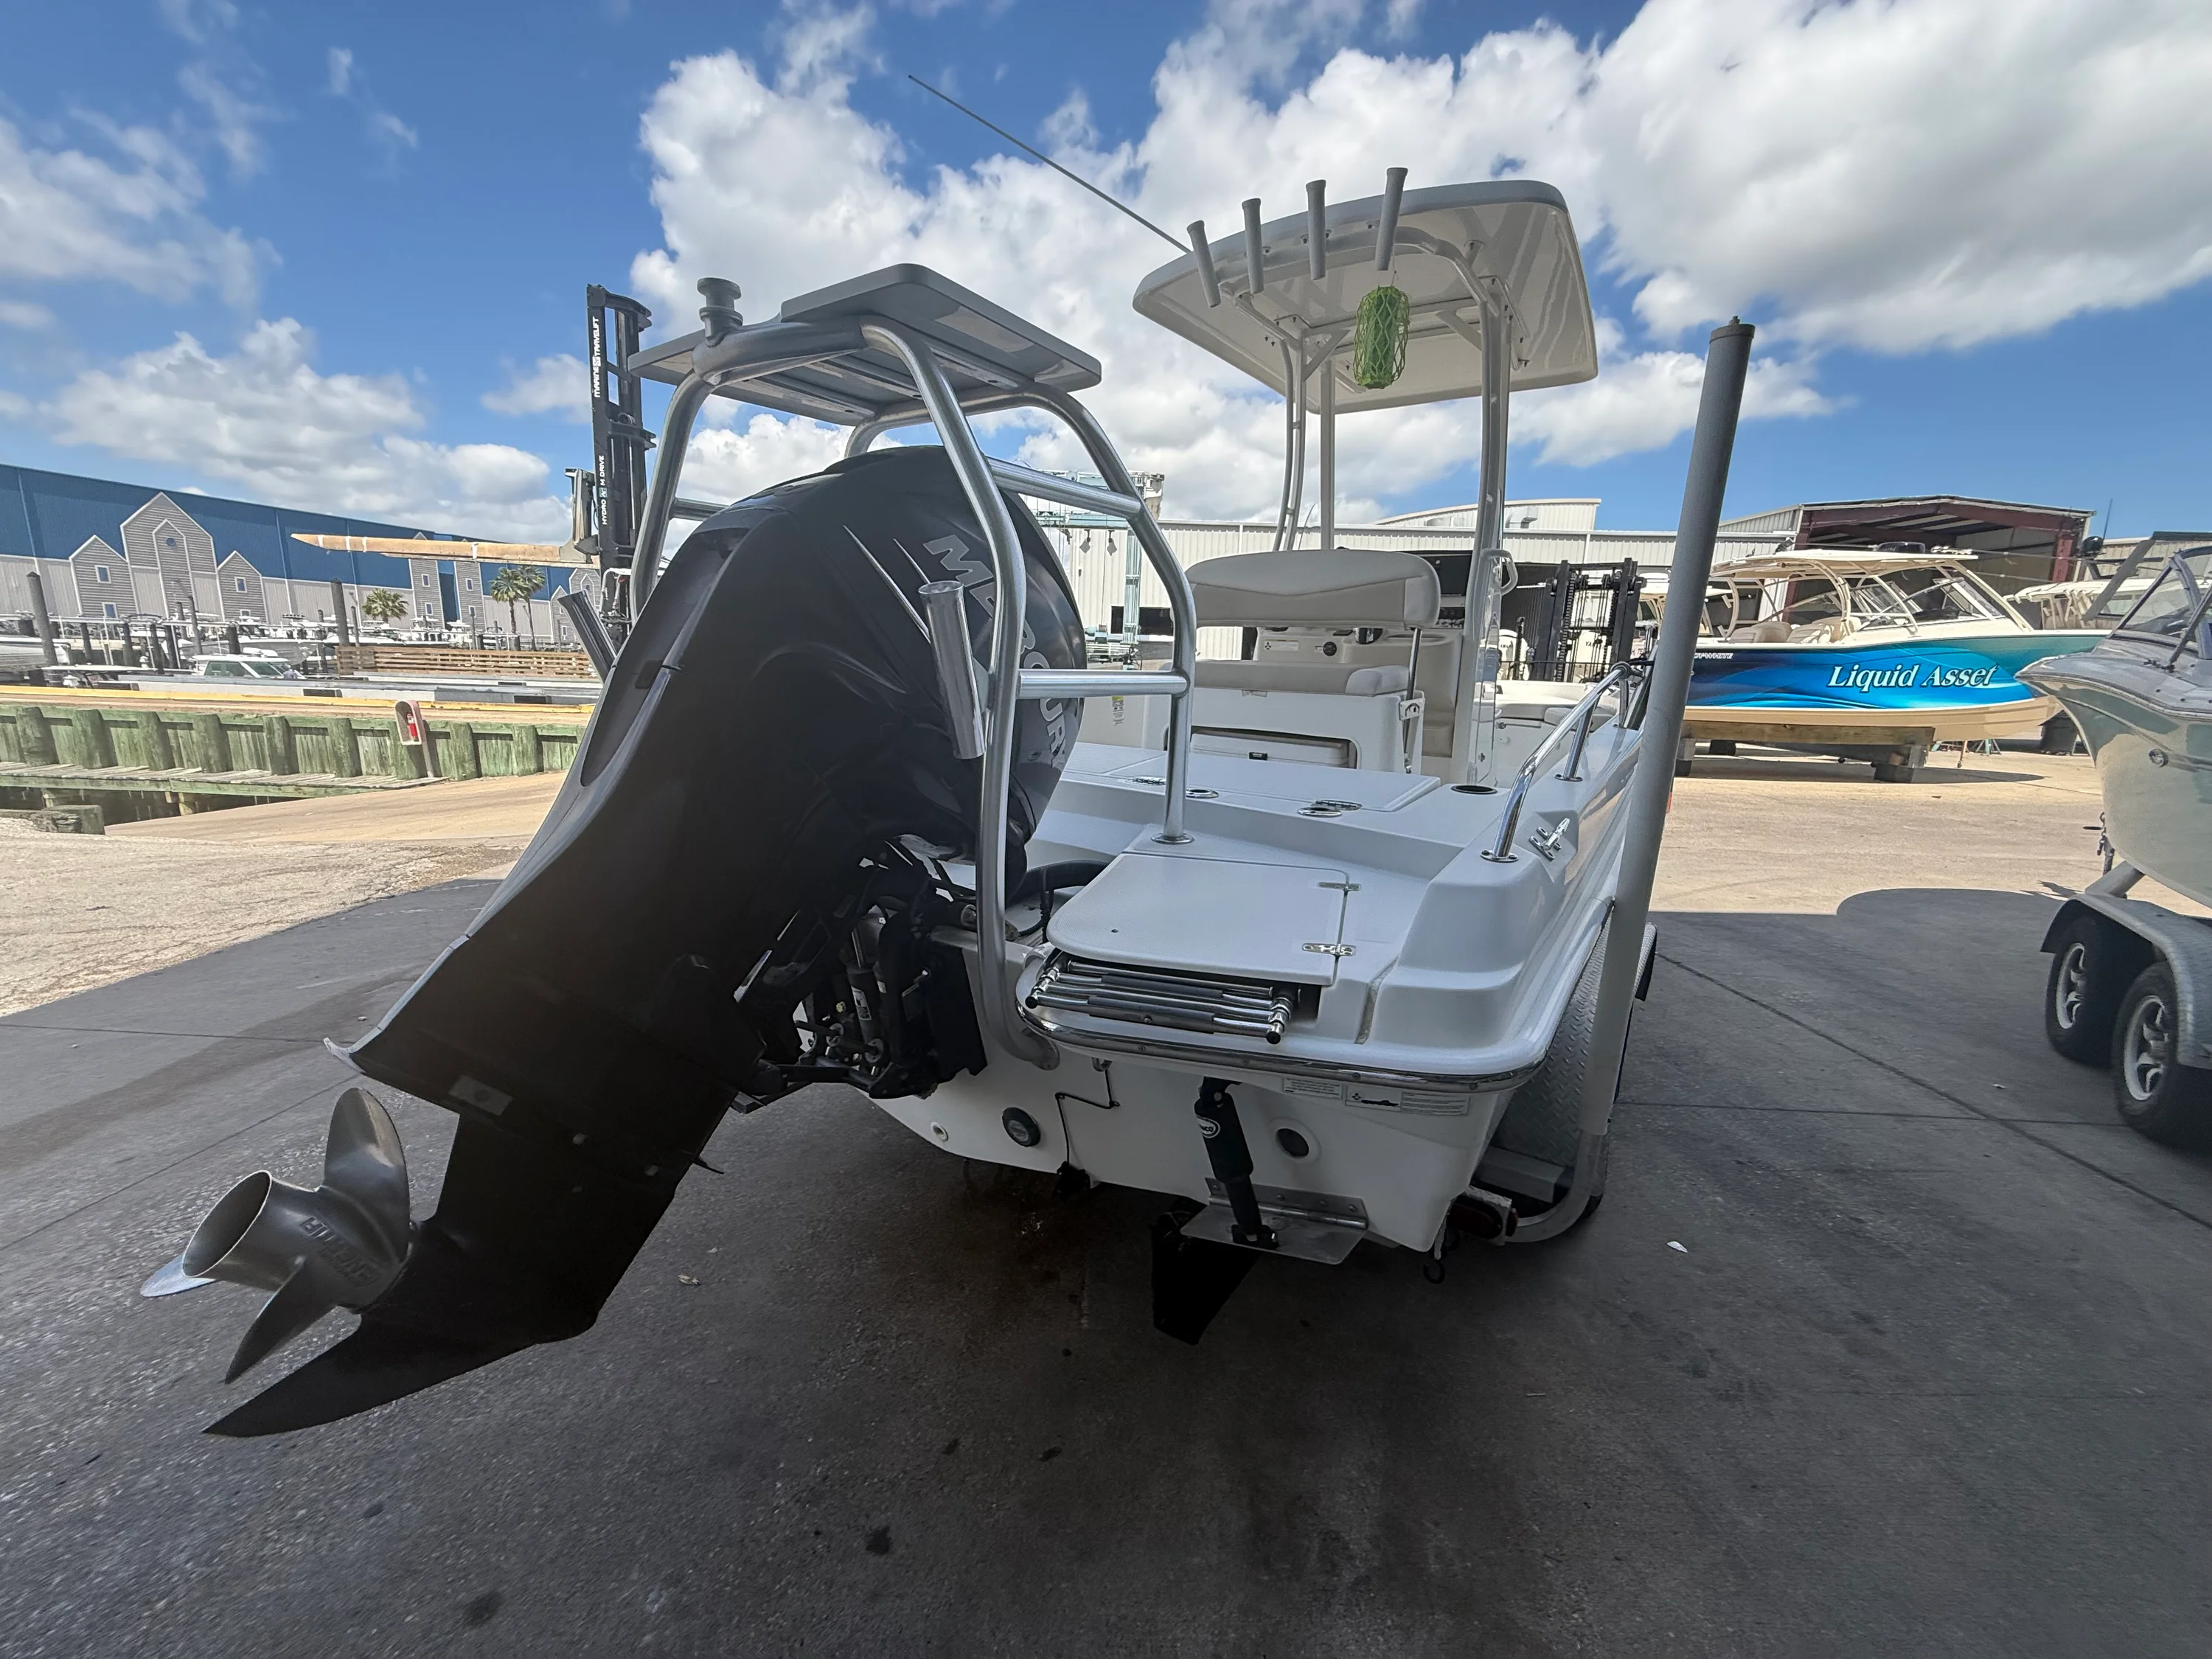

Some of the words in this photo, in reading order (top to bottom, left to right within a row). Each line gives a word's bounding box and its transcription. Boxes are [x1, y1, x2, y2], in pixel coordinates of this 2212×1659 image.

[592, 316, 601, 356] TRAVELIFT
[593, 365, 601, 398] MARINE
[1828, 664, 1920, 692] Liquid
[1921, 664, 1999, 686] Asset
